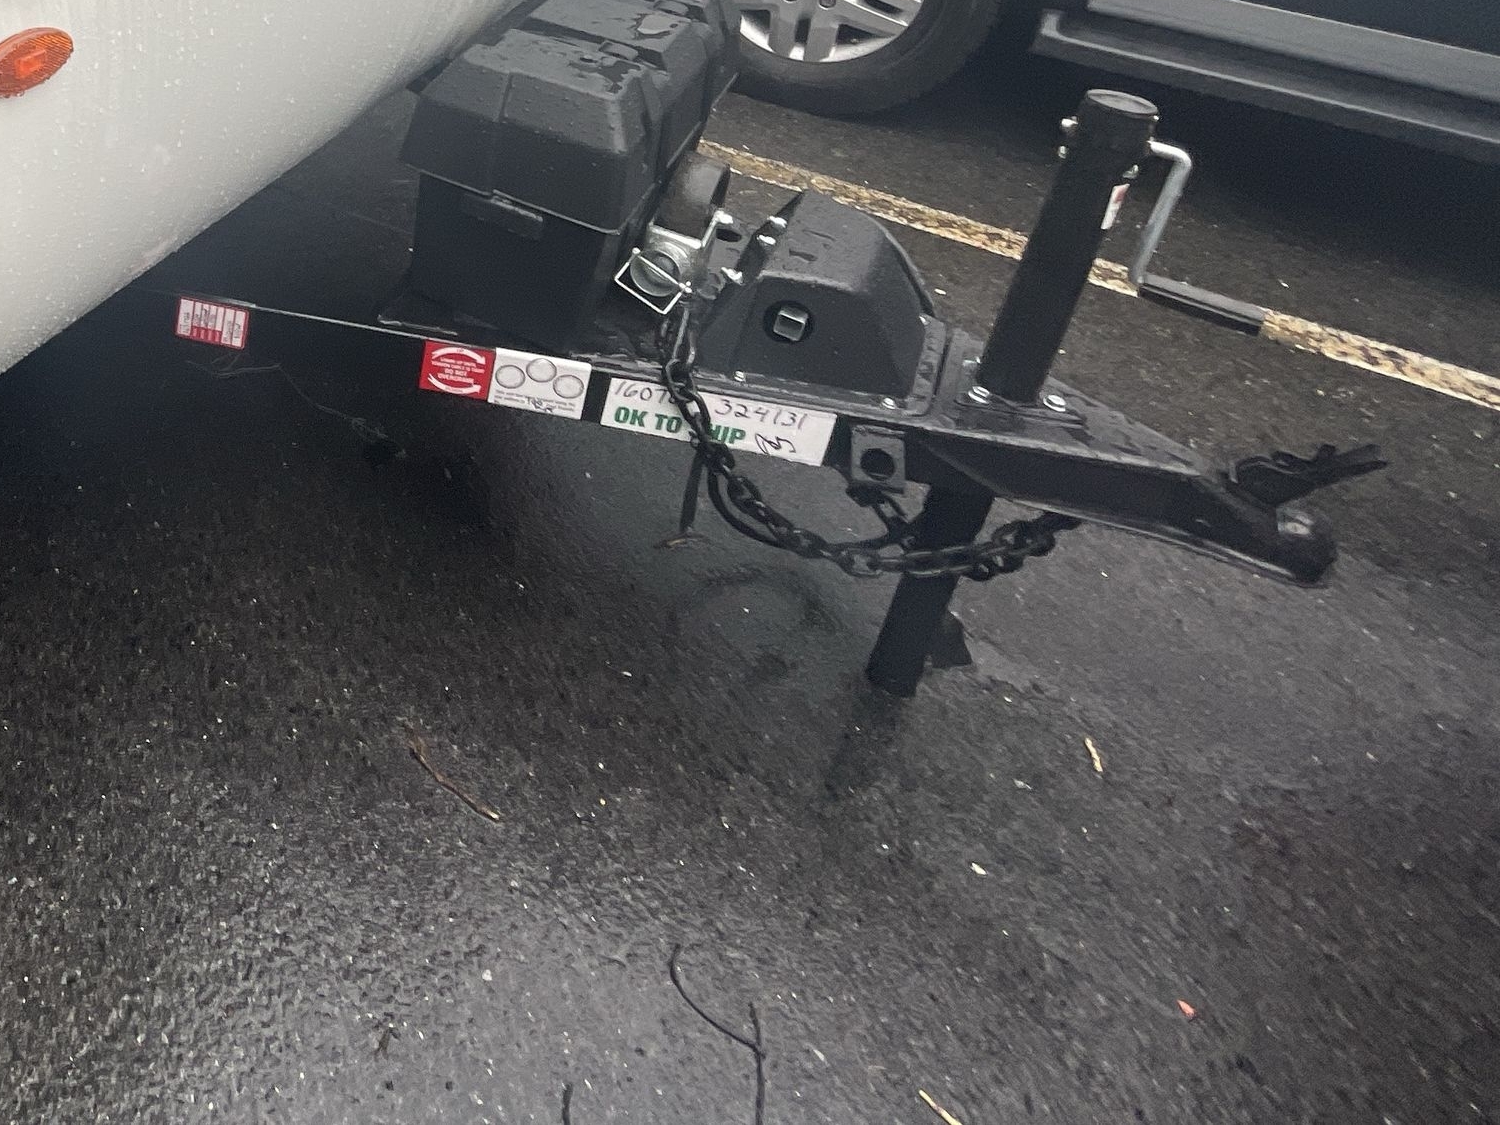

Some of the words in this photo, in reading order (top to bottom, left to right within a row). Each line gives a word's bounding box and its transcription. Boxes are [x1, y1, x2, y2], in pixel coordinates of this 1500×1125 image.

[614, 406, 647, 427] OK
[655, 413, 683, 433] TO
[714, 398, 809, 430] 324131
